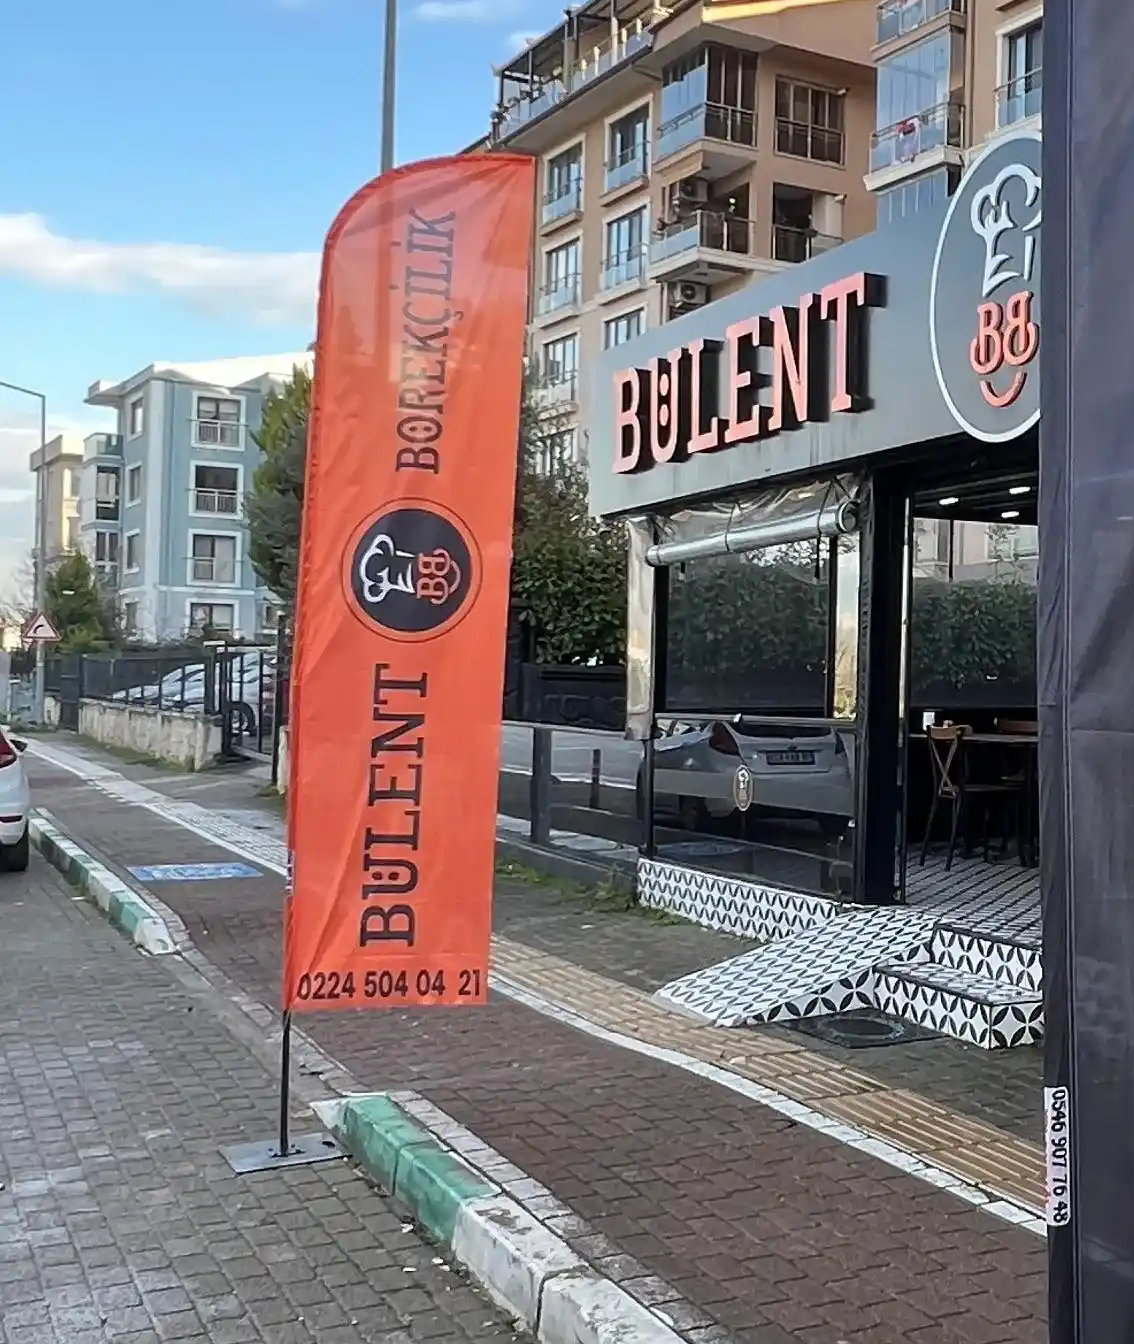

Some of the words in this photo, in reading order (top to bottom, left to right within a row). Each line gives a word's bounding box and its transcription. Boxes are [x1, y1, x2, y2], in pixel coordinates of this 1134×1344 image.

[389, 208, 465, 475] BÖREKÇİLİK
[611, 271, 868, 474] BÜLENT
[358, 663, 428, 947] BÜLENT
[297, 972, 356, 1000] 0224
[364, 970, 408, 998] 504
[416, 969, 446, 996] 04
[458, 969, 480, 996] 21
[1050, 1089, 1067, 1132] 0546
[1051, 1136, 1068, 1168] 907
[1052, 1174, 1068, 1196] 76
[1053, 1201, 1069, 1223] 48
